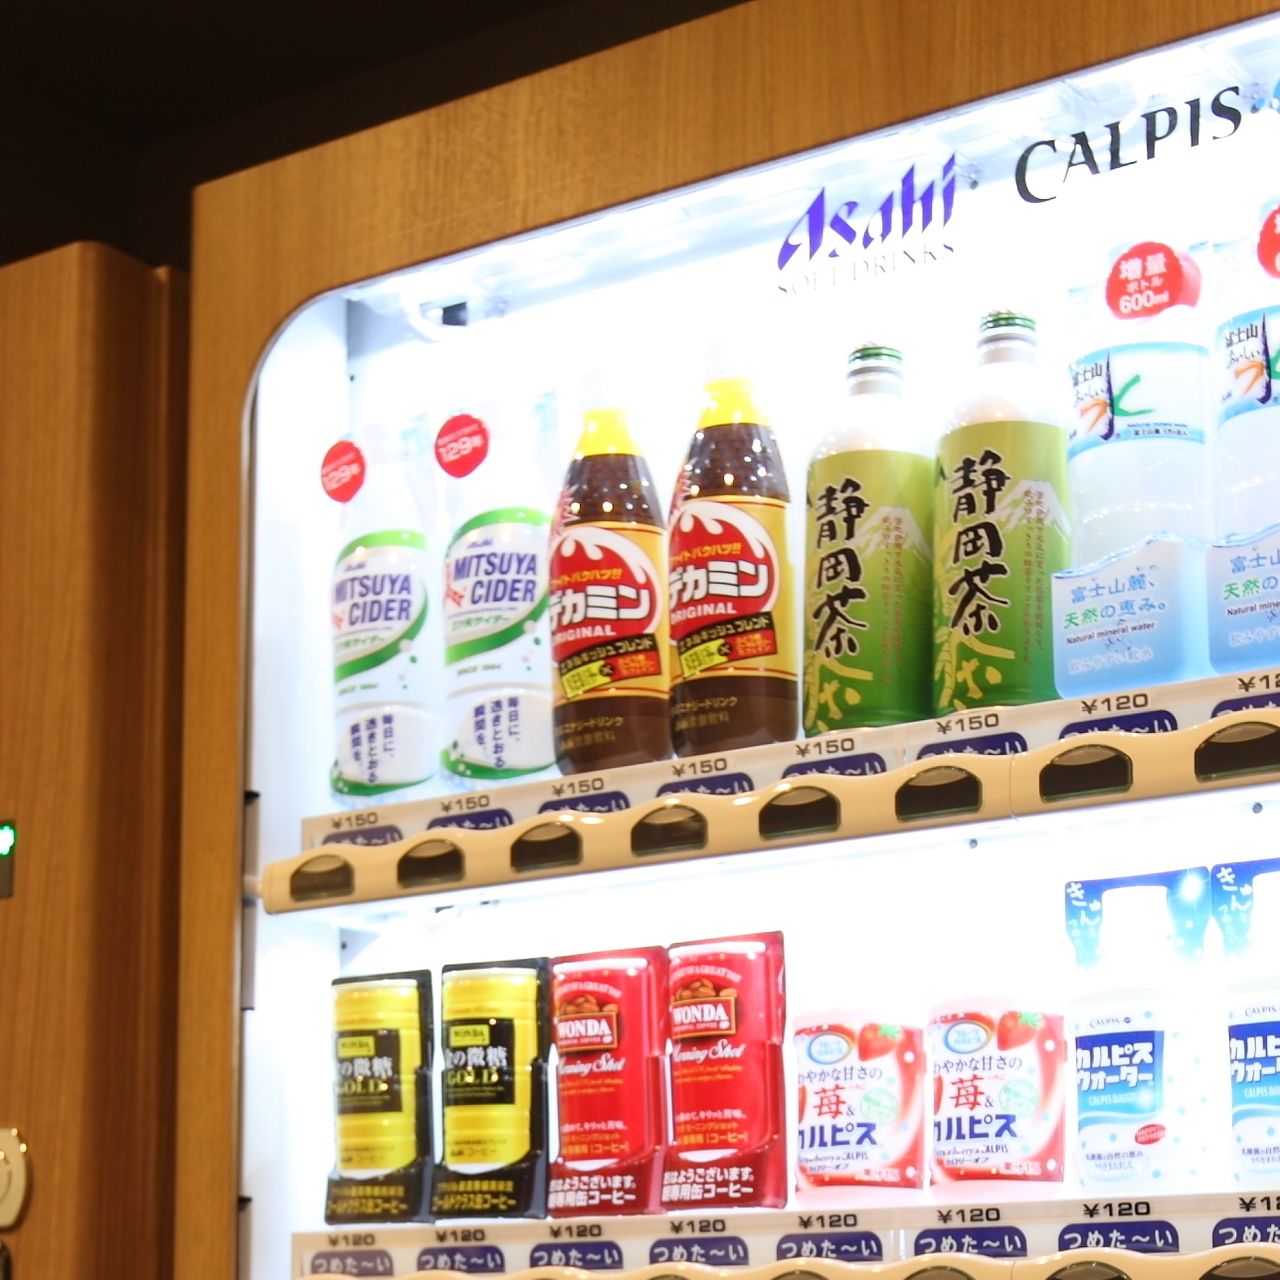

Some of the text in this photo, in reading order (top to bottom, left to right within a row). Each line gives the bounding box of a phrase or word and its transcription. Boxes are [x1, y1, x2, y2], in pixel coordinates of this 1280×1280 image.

[1015, 84, 1243, 205] CALPIS
[777, 152, 956, 271] Asahi
[1119, 252, 1167, 280] 増量
[1126, 276, 1164, 294] ボトル
[1119, 290, 1170, 315] 600ml
[947, 449, 1012, 636] 静岡茶
[452, 552, 537, 582] MITSUYA
[813, 477, 871, 659] 静岡茶
[334, 574, 412, 604] MITSUYA
[470, 579, 536, 605] CIDER
[1071, 572, 1156, 605] 富士山麓、
[348, 599, 411, 626] CIDER
[1063, 597, 1167, 630] 天然の恵み。
[1227, 604, 1257, 617] Natural
[1066, 620, 1155, 645] Natural mineral water
[1080, 693, 1149, 715] ¥120
[935, 713, 1000, 735] ¥150
[795, 737, 855, 758] ¥150
[671, 757, 728, 777] ¥150
[552, 776, 604, 797] ¥150
[440, 794, 490, 814] ¥150
[332, 811, 378, 830] ¥150
[672, 1003, 729, 1024] WONDA
[557, 1018, 612, 1039] WONDA
[1075, 1041, 1154, 1069] カルピス
[812, 1083, 847, 1120] 苺
[949, 1074, 985, 1111] 苺
[936, 1207, 1001, 1224] ¥120
[1083, 1200, 1151, 1218] ¥120
[549, 1223, 603, 1239] ¥120
[669, 1218, 726, 1235] ¥120
[798, 1213, 858, 1230] ¥120
[328, 1233, 375, 1247] ¥120
[435, 1228, 485, 1243] ¥120
